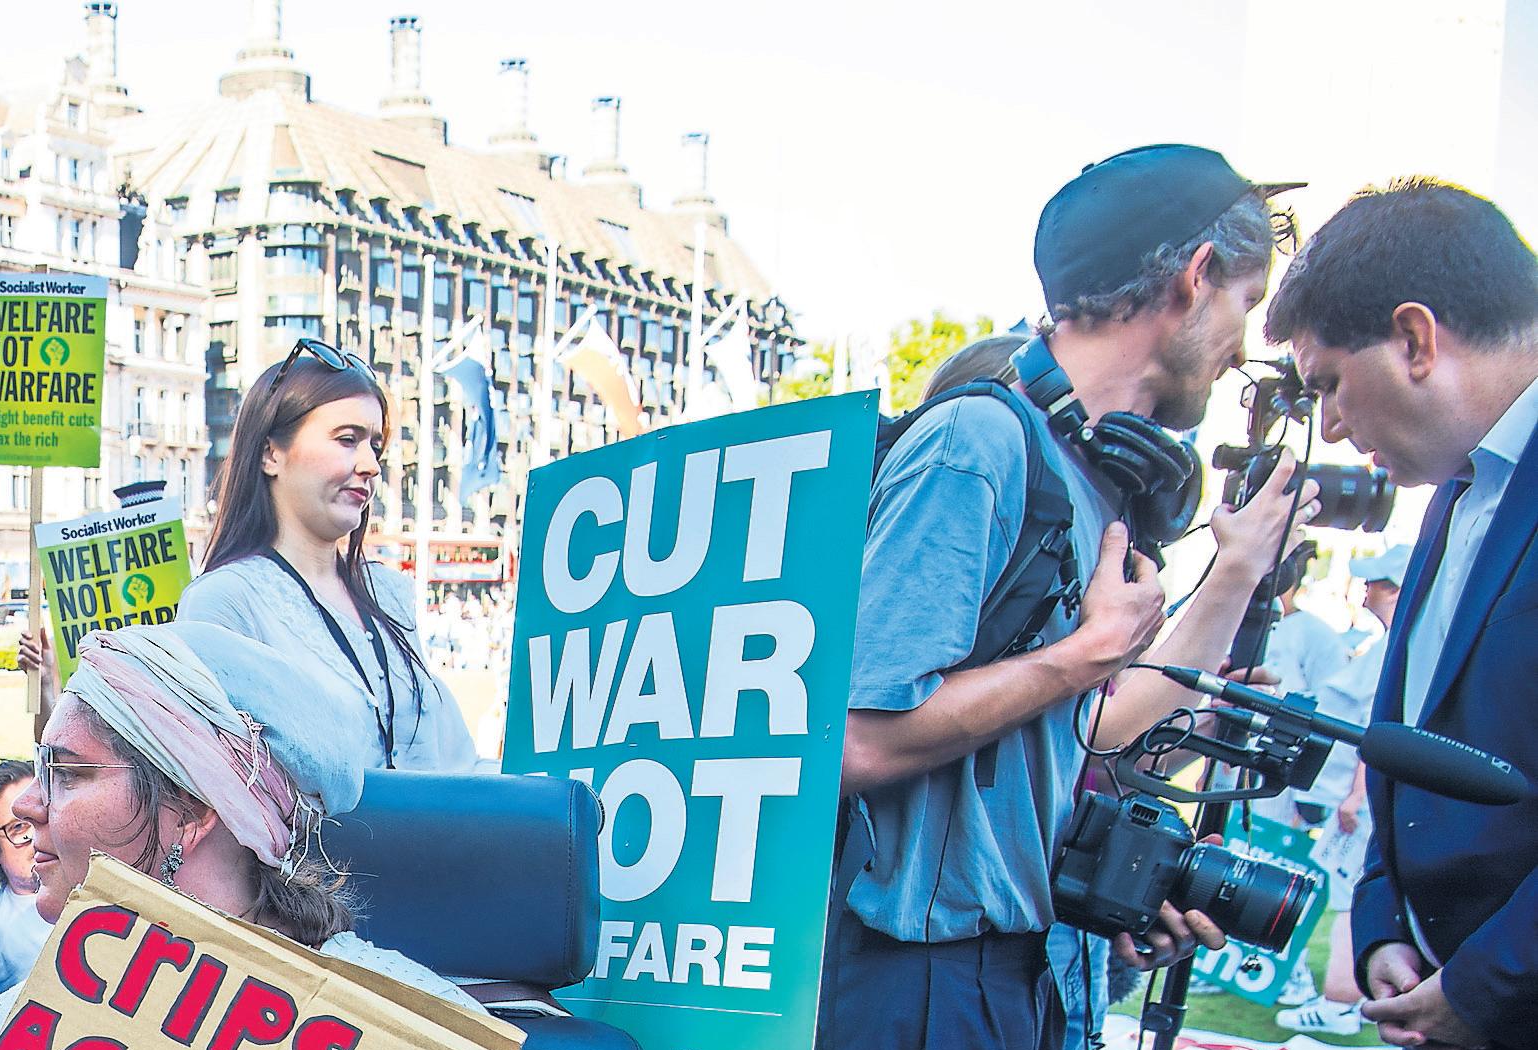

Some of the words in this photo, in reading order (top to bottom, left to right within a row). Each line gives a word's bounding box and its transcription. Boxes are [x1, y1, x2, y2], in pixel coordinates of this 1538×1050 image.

[0, 281, 45, 294] Socialist
[45, 281, 86, 295] Worker
[14, 431, 31, 446] the
[35, 431, 58, 447] rich
[23, 411, 64, 427] benefit
[69, 413, 94, 427] cuts
[61, 521, 113, 541] Socialist
[113, 512, 157, 531] Worker
[542, 429, 832, 614] CUT
[48, 528, 177, 585] WELFARE
[56, 580, 112, 622] NOT
[529, 599, 817, 754] WAR
[524, 757, 802, 902] OT
[591, 920, 776, 991] FARE
